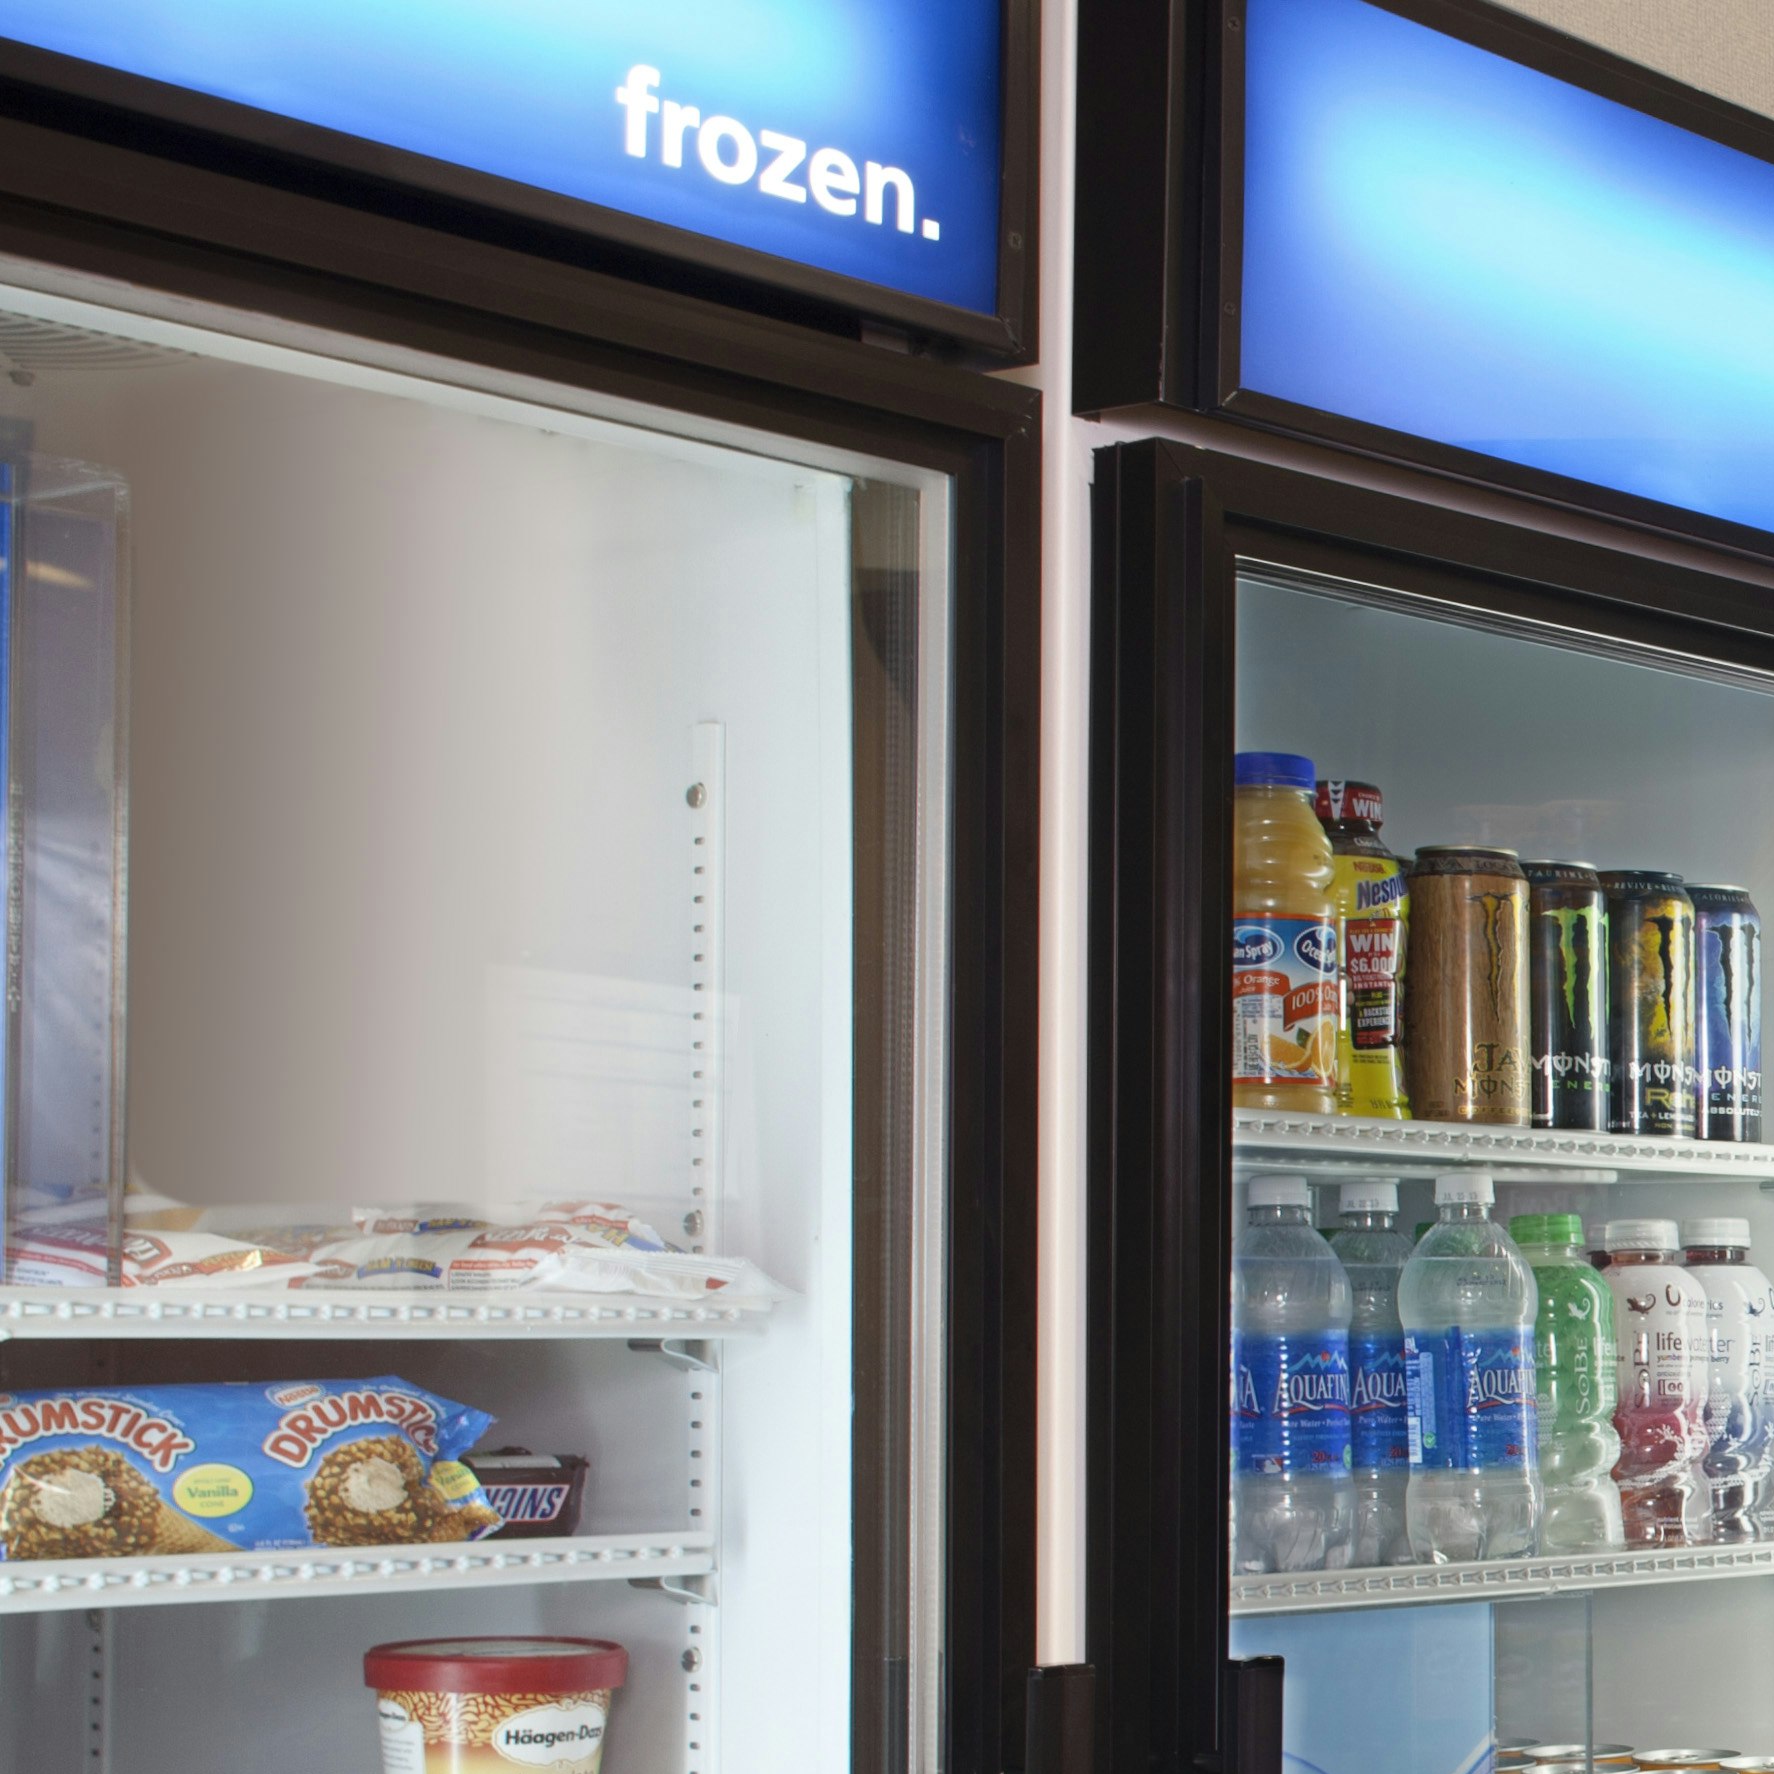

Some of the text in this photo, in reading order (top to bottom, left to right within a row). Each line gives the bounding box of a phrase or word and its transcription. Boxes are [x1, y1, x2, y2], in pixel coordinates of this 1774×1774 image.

[615, 64, 941, 240] frozen.
[1245, 942, 1273, 960] Spray
[1350, 934, 1394, 953] WIN
[1243, 976, 1280, 988] Orange
[1656, 1332, 1682, 1351] life
[1273, 1369, 1350, 1412] AQUAFIN
[0, 1399, 196, 1473] UMSTICK
[186, 1485, 239, 1498] Vanilla
